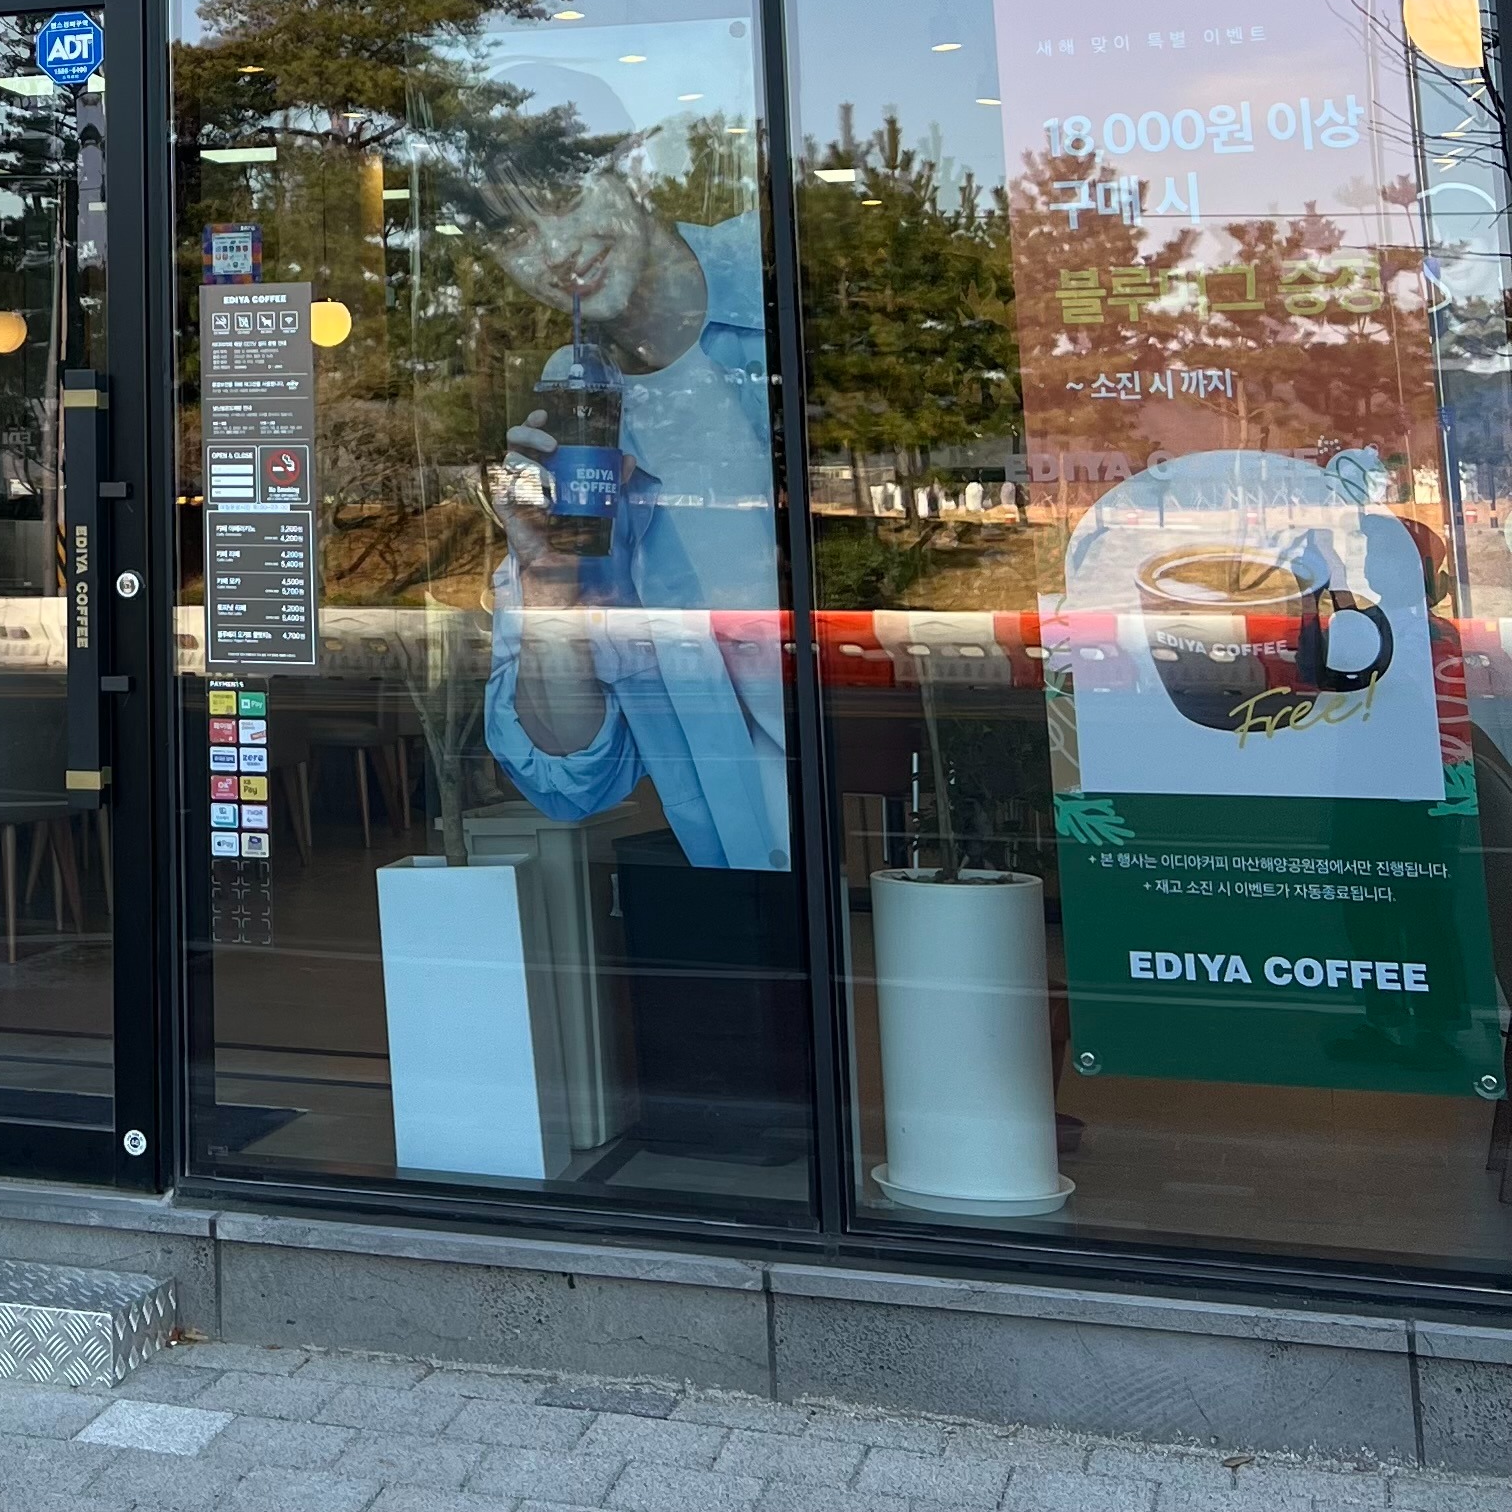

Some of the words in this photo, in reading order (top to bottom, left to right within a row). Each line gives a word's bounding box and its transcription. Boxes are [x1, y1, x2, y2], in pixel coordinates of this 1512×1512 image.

[47, 33, 93, 62] ADT
[1036, 38, 1075, 56] 새해
[1090, 34, 1130, 53] 맞이
[1146, 30, 1186, 49] 특별
[1203, 25, 1266, 46] 이벤트
[1042, 100, 1254, 163] 18,000원
[1266, 94, 1366, 150] 이상
[1048, 174, 1144, 230] 구매
[1155, 171, 1201, 224] 시
[1090, 371, 1142, 399] 소진
[1149, 370, 1175, 399] 시
[1180, 368, 1233, 399] 까지
[570, 480, 617, 494] COFFEE
[576, 468, 614, 481] EDIYA
[75, 525, 88, 575] EDIYA
[75, 581, 89, 649] COFFEE
[1155, 630, 1205, 654] EDIYA
[1211, 639, 1289, 658] COFFEE
[1228, 670, 1380, 749] Free!
[1100, 853, 1114, 868] 본
[1117, 853, 1157, 869] 행사는
[1161, 855, 1229, 872] 이디야커피
[1232, 856, 1372, 876] 마산해양공원점에서만
[1375, 861, 1451, 879] 진행됩니다.
[1155, 879, 1183, 894] 재고
[1186, 880, 1213, 896] 소진
[1218, 881, 1231, 896] 시
[1235, 881, 1290, 899] 이벤트가
[1293, 884, 1396, 903] 자동종료됩니다.
[1128, 950, 1252, 984] EDIYA
[1263, 956, 1430, 992] COFFEE
